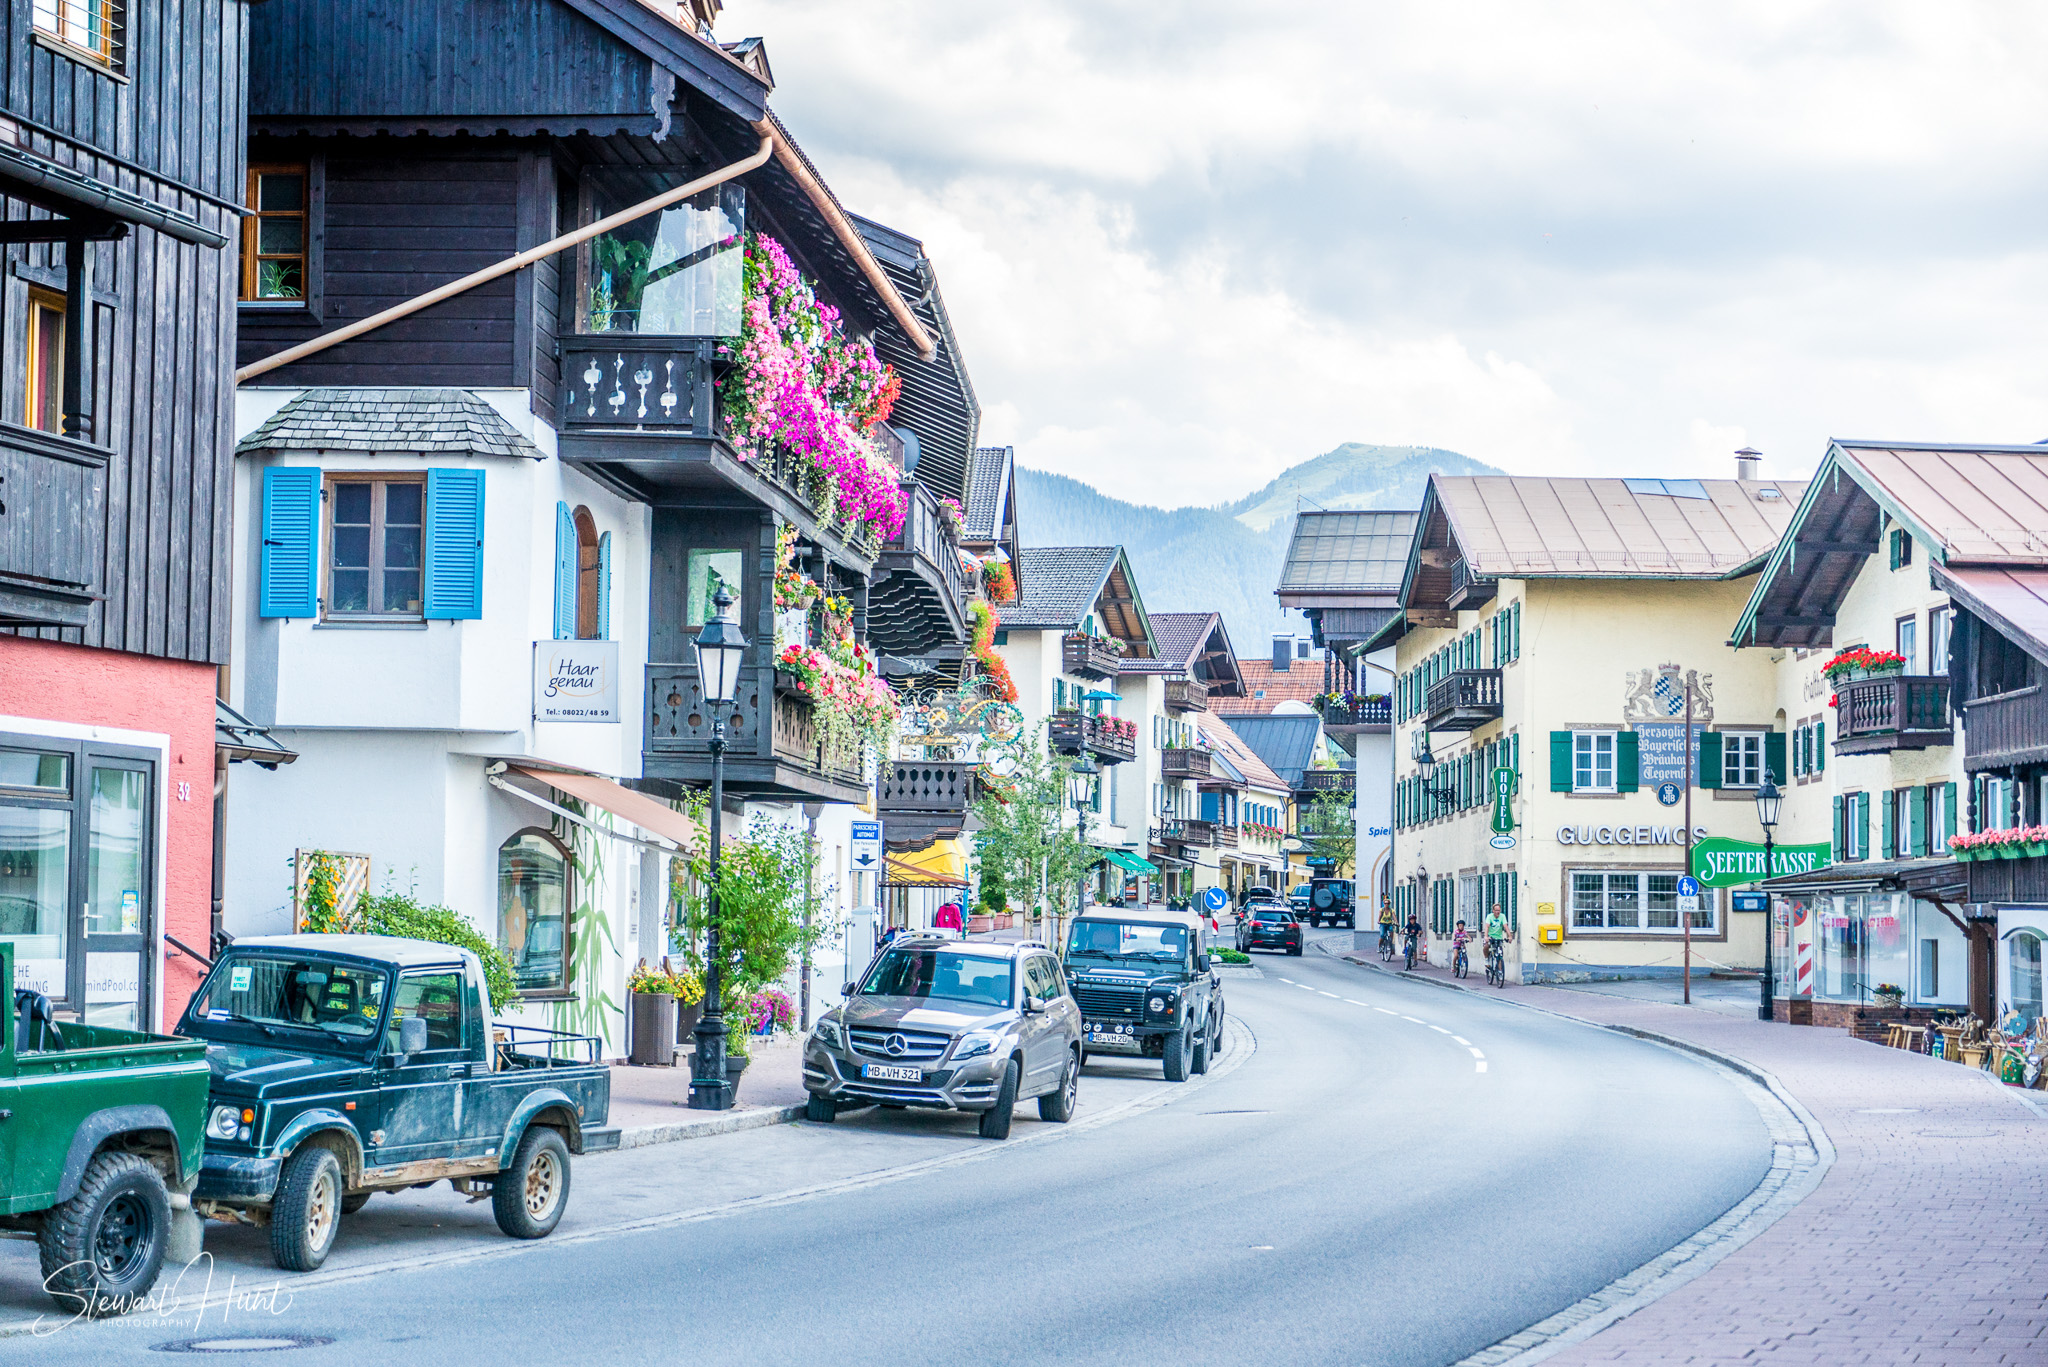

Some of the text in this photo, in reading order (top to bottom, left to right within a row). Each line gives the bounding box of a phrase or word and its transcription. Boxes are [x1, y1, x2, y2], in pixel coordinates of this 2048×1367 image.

[558, 659, 599, 675] Haar
[544, 677, 594, 697] genau
[1635, 725, 1692, 739] Herzoglic
[1643, 766, 1694, 781] Tegernse
[178, 781, 190, 801] 32
[1500, 772, 1508, 828] HOTEL
[1557, 825, 1708, 846] GUGGEMOS
[1700, 852, 1817, 881] SEETERRASSE
[1092, 1033, 1103, 1041] MB
[1106, 1034, 1117, 1042] VH
[867, 1065, 920, 1081] MB VH 321
